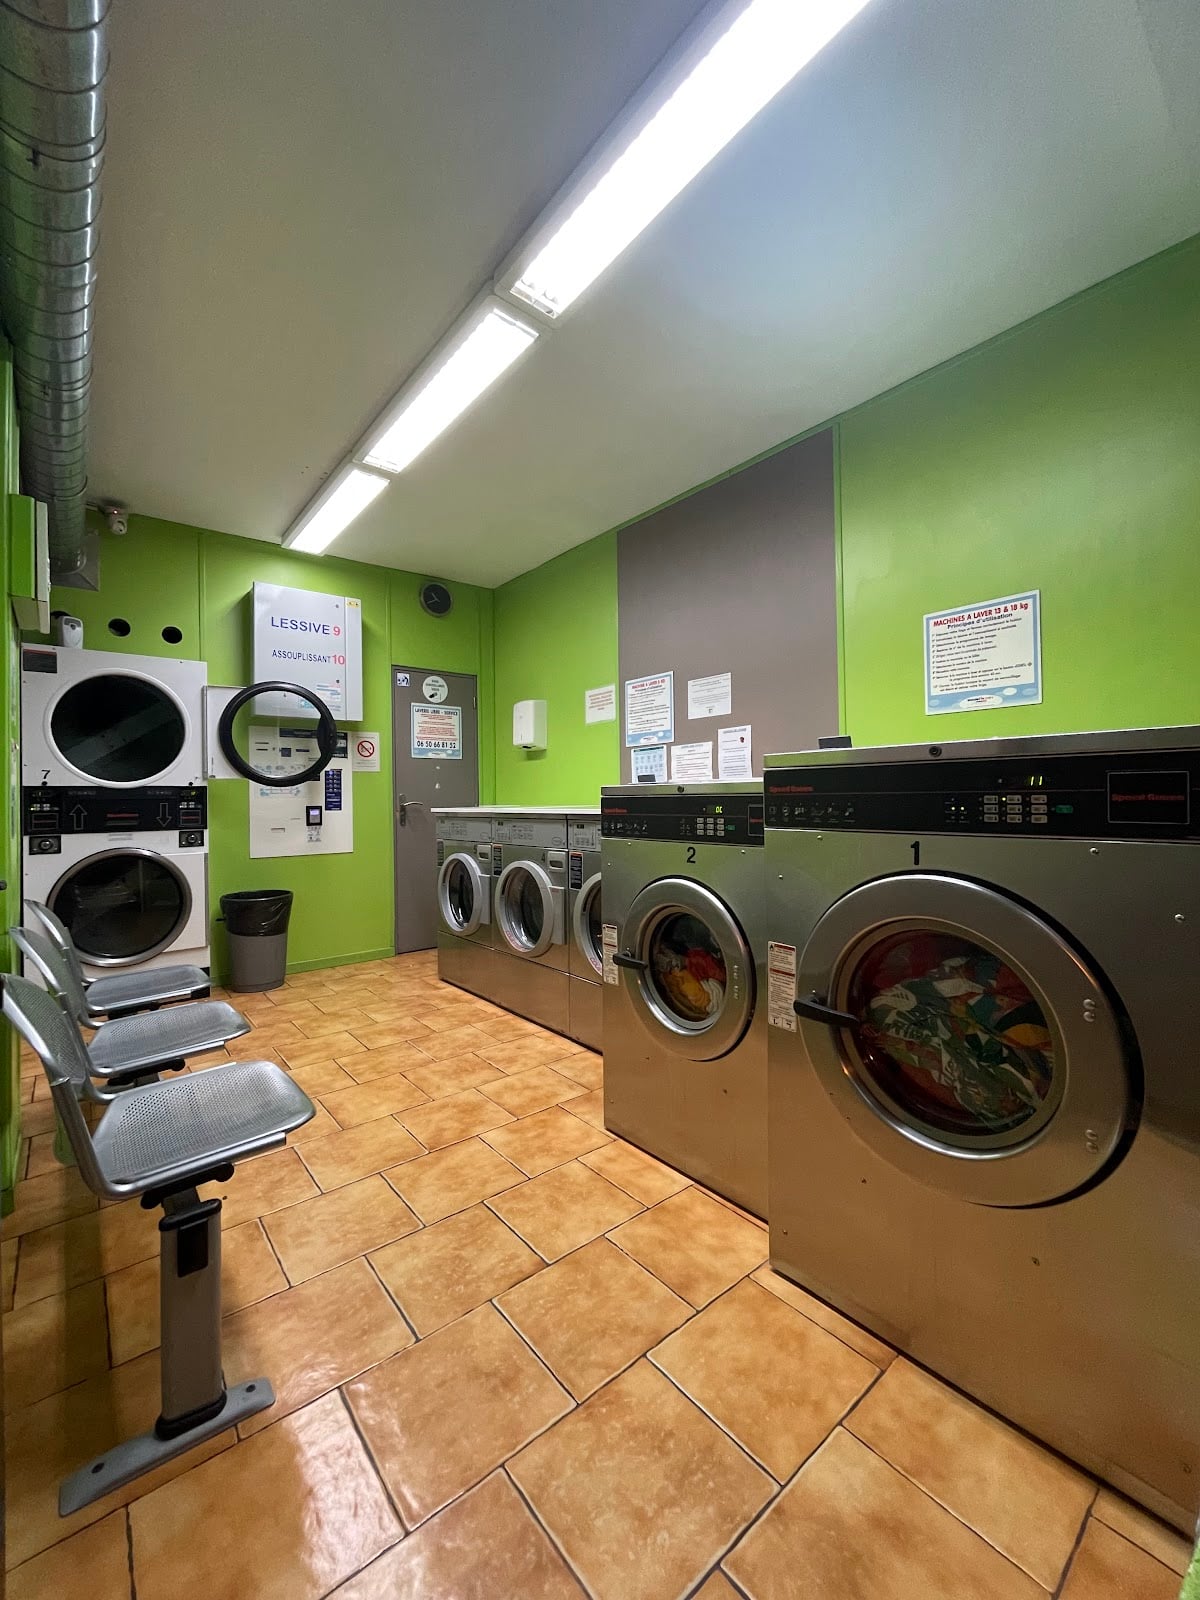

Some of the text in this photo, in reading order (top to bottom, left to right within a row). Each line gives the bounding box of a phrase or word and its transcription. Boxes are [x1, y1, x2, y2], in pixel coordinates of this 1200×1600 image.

[933, 615, 966, 627] MACHINES
[966, 613, 972, 621] A
[973, 609, 993, 619] LAVER
[994, 607, 1002, 615] 13
[1019, 602, 1029, 611] kg
[947, 612, 1013, 629] Principes d'utilisation
[271, 616, 341, 636] LESSIVE 9
[272, 649, 345, 665] ASSOUPLISSANT 10
[416, 740, 424, 748] 06
[41, 769, 51, 780] 7
[686, 846, 697, 864] 2
[910, 841, 920, 866] 1
